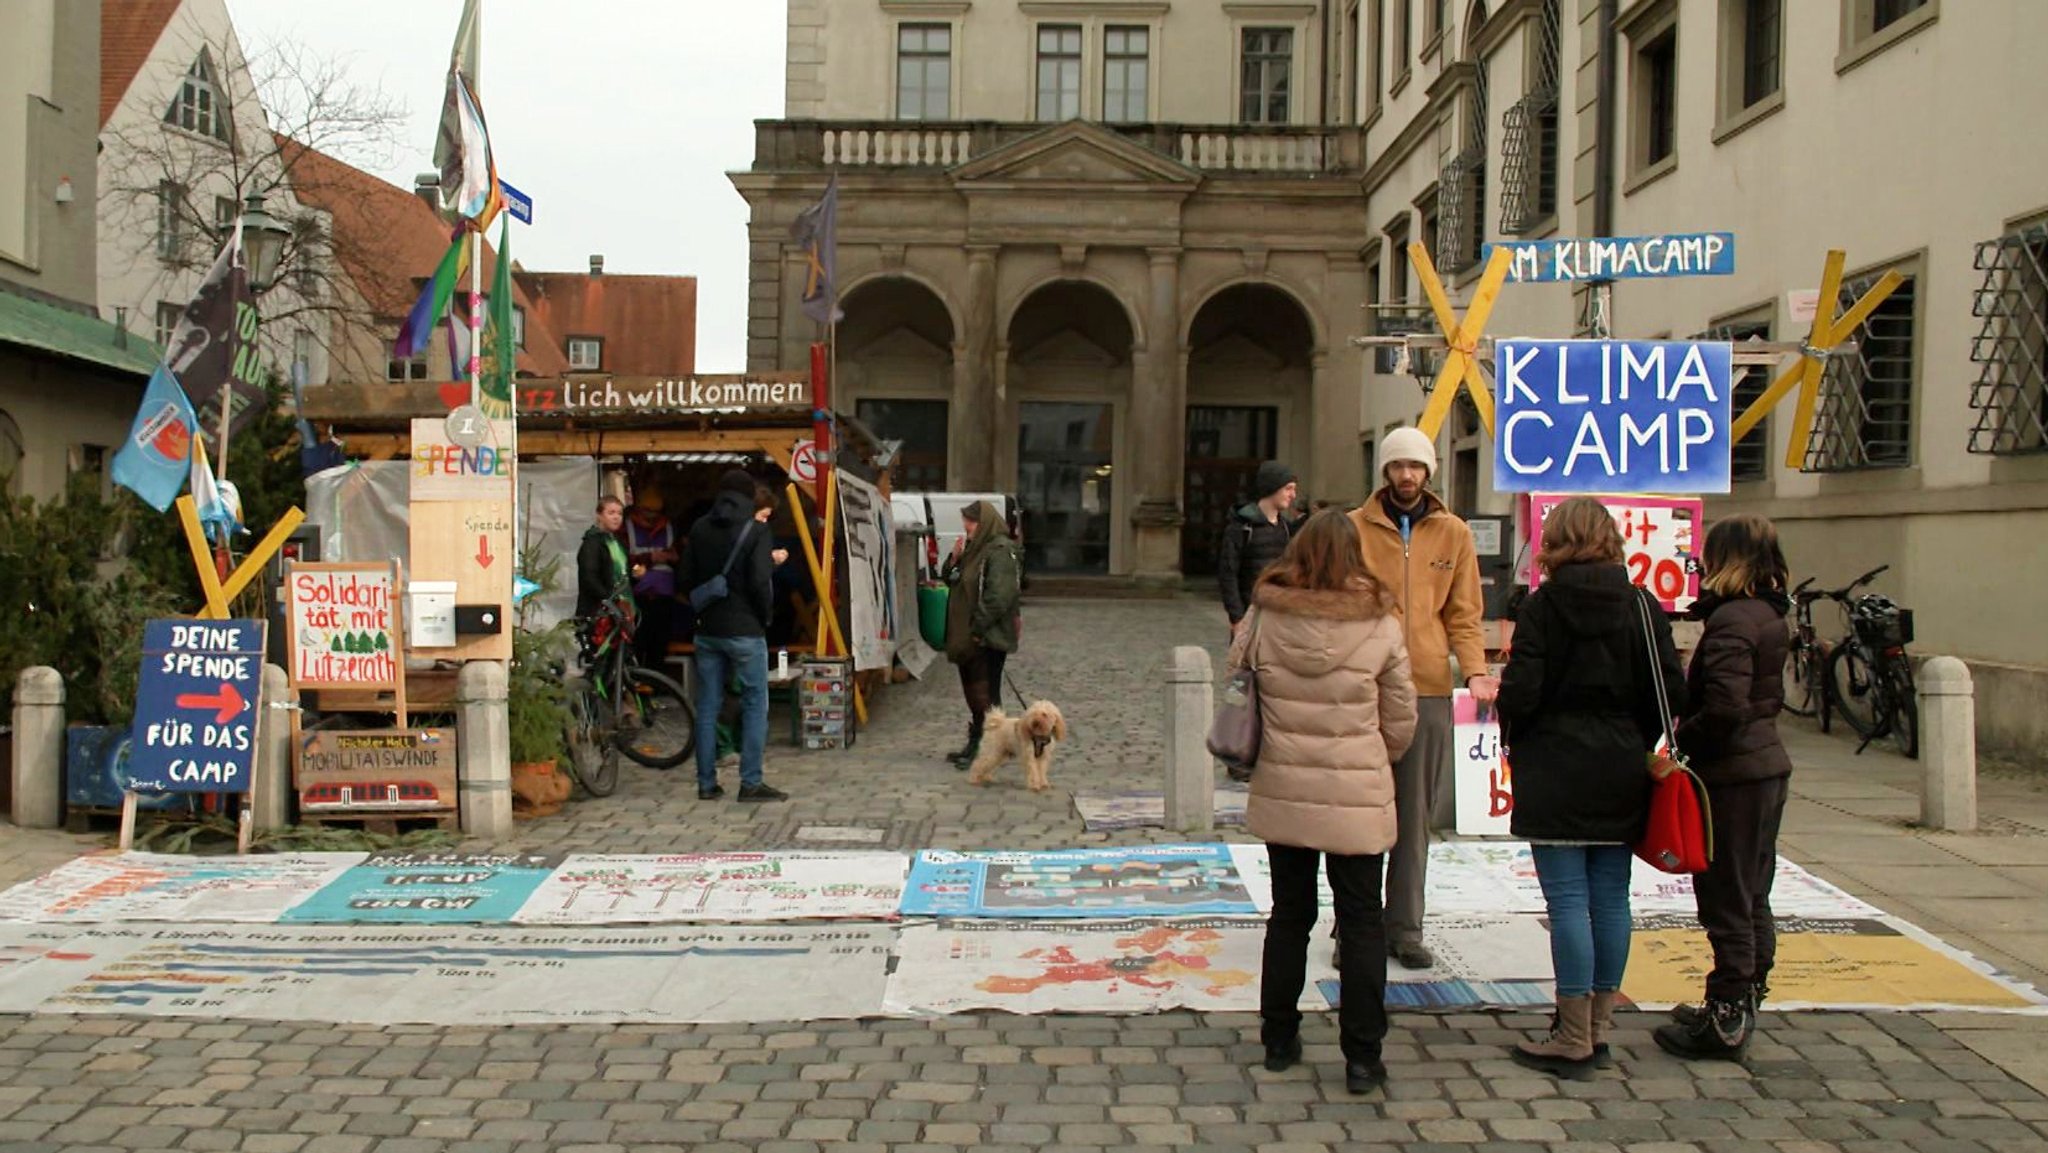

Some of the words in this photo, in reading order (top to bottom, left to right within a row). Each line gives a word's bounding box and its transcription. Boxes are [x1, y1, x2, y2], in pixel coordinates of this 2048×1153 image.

[1554, 234, 1724, 281] KLIMACAMP
[1503, 343, 1719, 405] KLIMA
[628, 379, 803, 406] willkommen
[459, 417, 475, 435] 1
[1503, 407, 1716, 477] CAMP
[414, 443, 511, 478] SPENDE
[1624, 509, 1658, 546] it
[304, 606, 341, 629] tät
[351, 608, 389, 630] mit
[170, 625, 242, 652] DEINE
[161, 652, 250, 681] SPENDE
[301, 649, 397, 683] Lützerath
[147, 719, 194, 747] FÜR
[203, 725, 250, 752] DAS
[168, 758, 238, 785] CAMP
